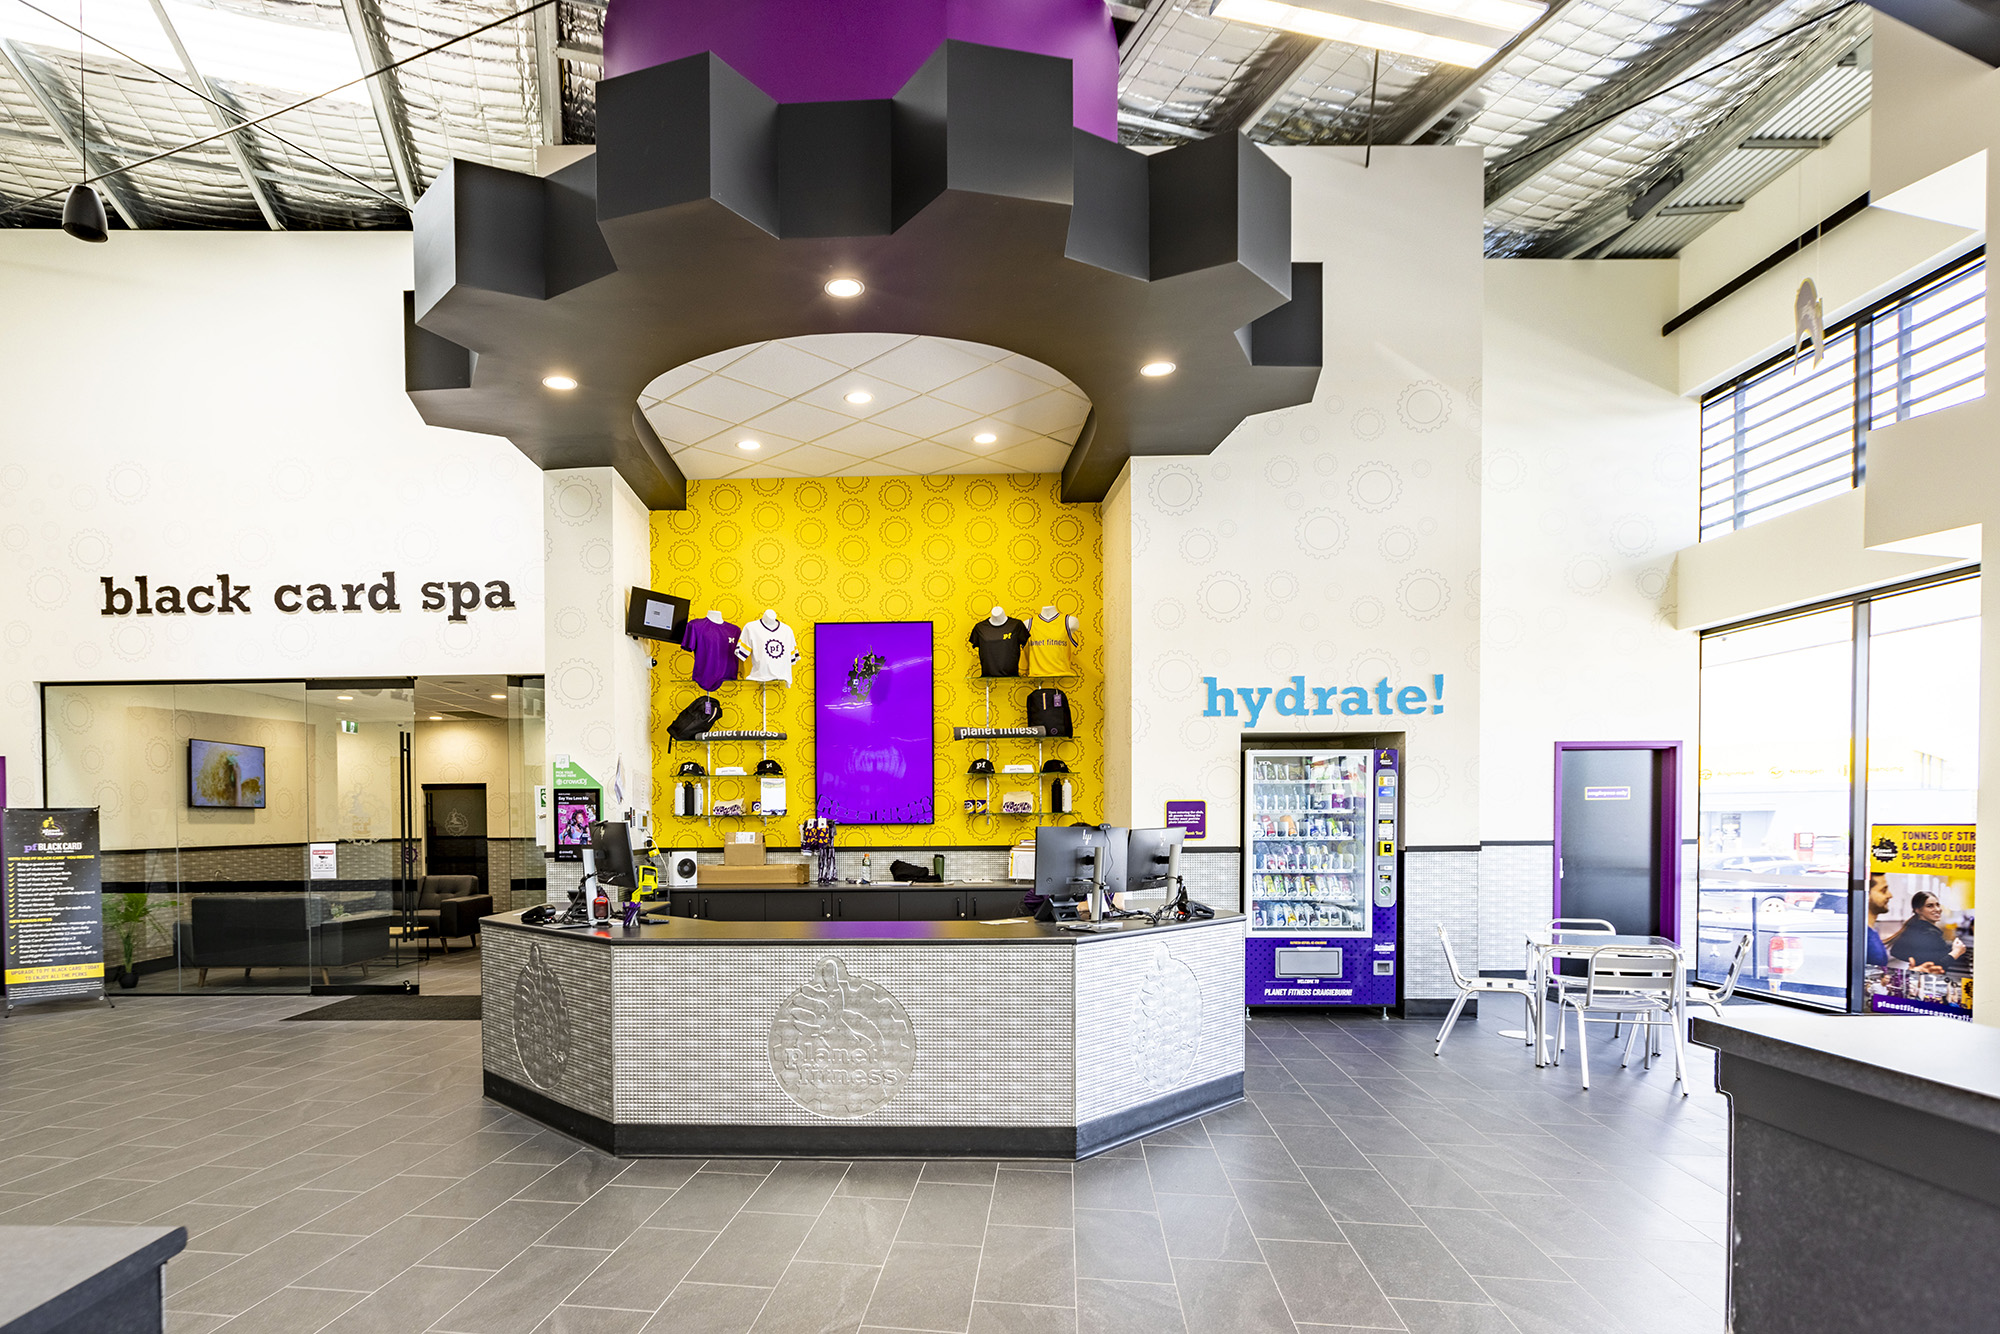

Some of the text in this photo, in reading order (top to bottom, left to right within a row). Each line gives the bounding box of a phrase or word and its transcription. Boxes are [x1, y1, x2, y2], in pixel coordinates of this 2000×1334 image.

[100, 572, 517, 623] black card spa
[770, 644, 780, 653] pf
[1202, 674, 1444, 728] hydrate!
[702, 731, 737, 740] planet
[960, 727, 996, 739] planet
[1902, 831, 1976, 840] TONNES OF STR
[38, 843, 62, 851] BLACK
[63, 842, 82, 850] CARD
[1902, 843, 1908, 851] &
[1912, 843, 1947, 851] CARDIO
[784, 1042, 878, 1070] planet
[799, 1063, 898, 1085] fitness
